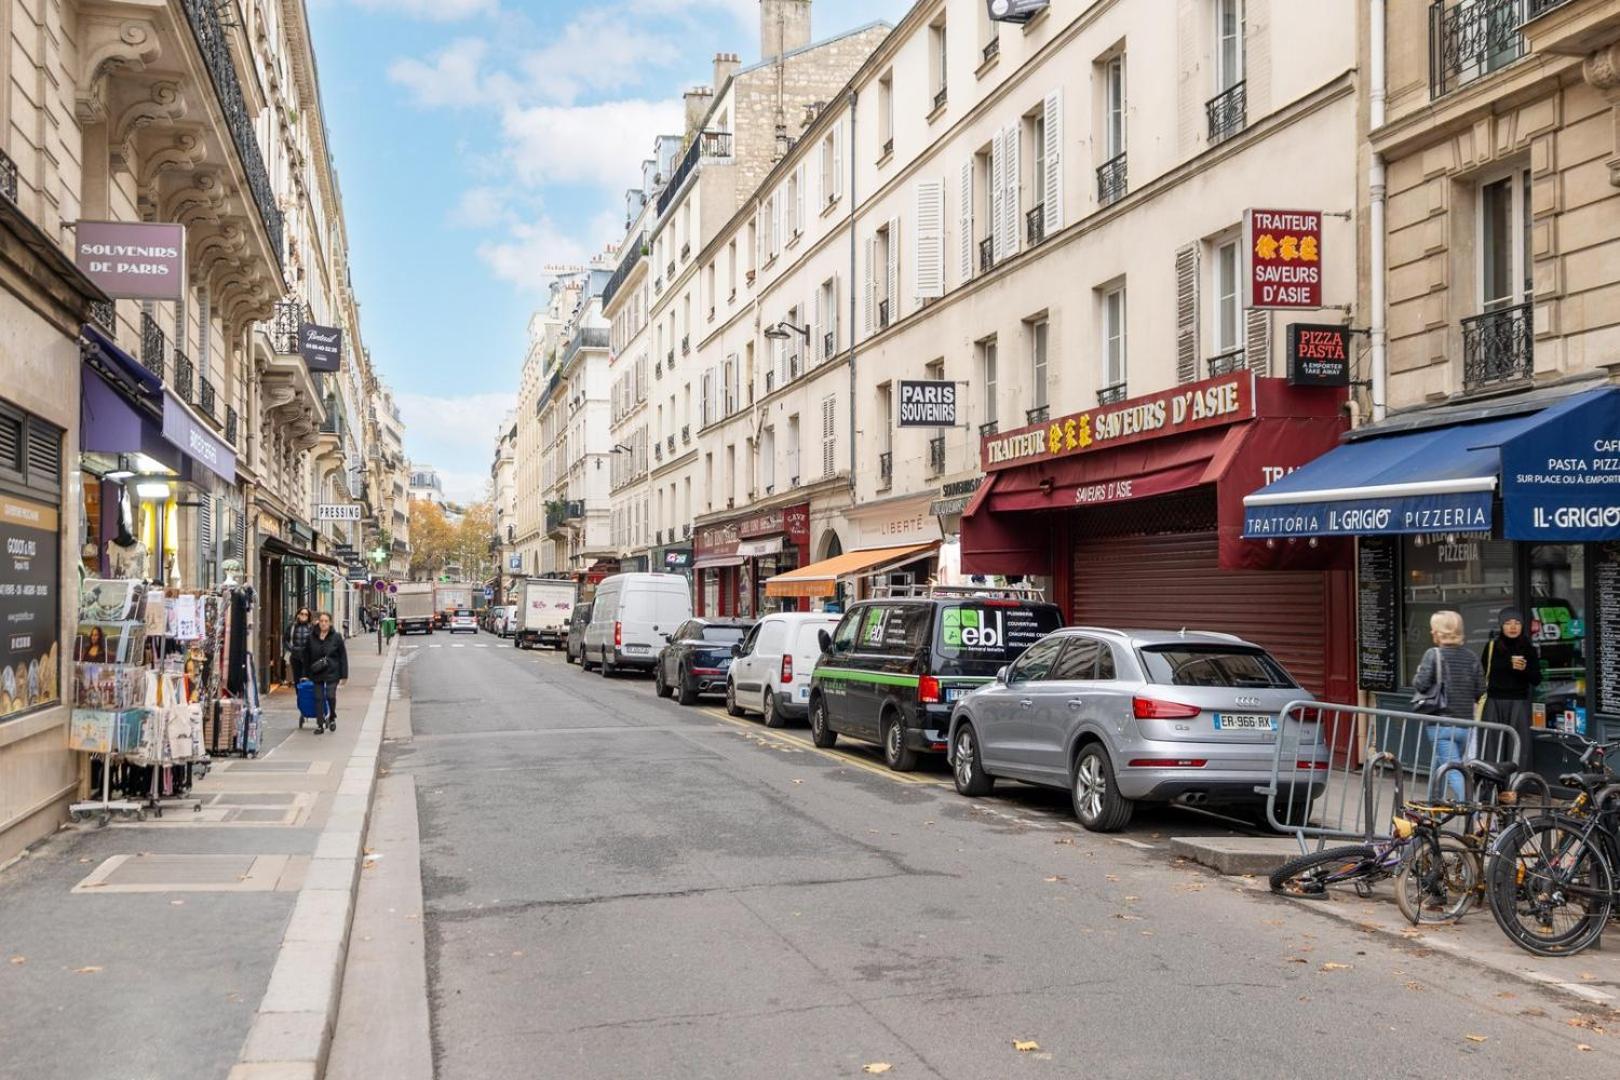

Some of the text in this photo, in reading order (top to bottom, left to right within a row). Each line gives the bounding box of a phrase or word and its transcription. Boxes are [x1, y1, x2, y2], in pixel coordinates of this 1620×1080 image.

[1255, 213, 1317, 231] TRAITEUR
[81, 243, 178, 258] SOUVENIRS
[90, 261, 169, 275] DE PARIS
[1256, 265, 1318, 283] SAVEURS
[1263, 285, 1311, 303] D'ASIE
[1301, 330, 1343, 345] PIZZA
[1299, 344, 1345, 359] PASTA
[902, 386, 954, 404] PARIS
[902, 403, 955, 421] SOUVENIRS
[987, 429, 1046, 464] TRAITEUR
[1095, 400, 1166, 440] SAVEURS
[1172, 382, 1240, 424] D'ASIE
[1548, 459, 1620, 471] PASTA PIZZ
[1517, 474, 1534, 483] SUR
[1535, 474, 1561, 484] PLACE
[1562, 475, 1576, 484] OU
[1577, 473, 1585, 484] À
[1076, 484, 1107, 503] SAVEURS
[320, 502, 360, 518] PRESSING
[881, 514, 923, 535] LIBERTÉ
[1248, 515, 1319, 534] TRATTORIA
[1405, 506, 1486, 528] PIZZERIA
[1438, 543, 1479, 563] PIZZERIA
[871, 609, 890, 642] ebl
[961, 609, 1004, 647] ebl
